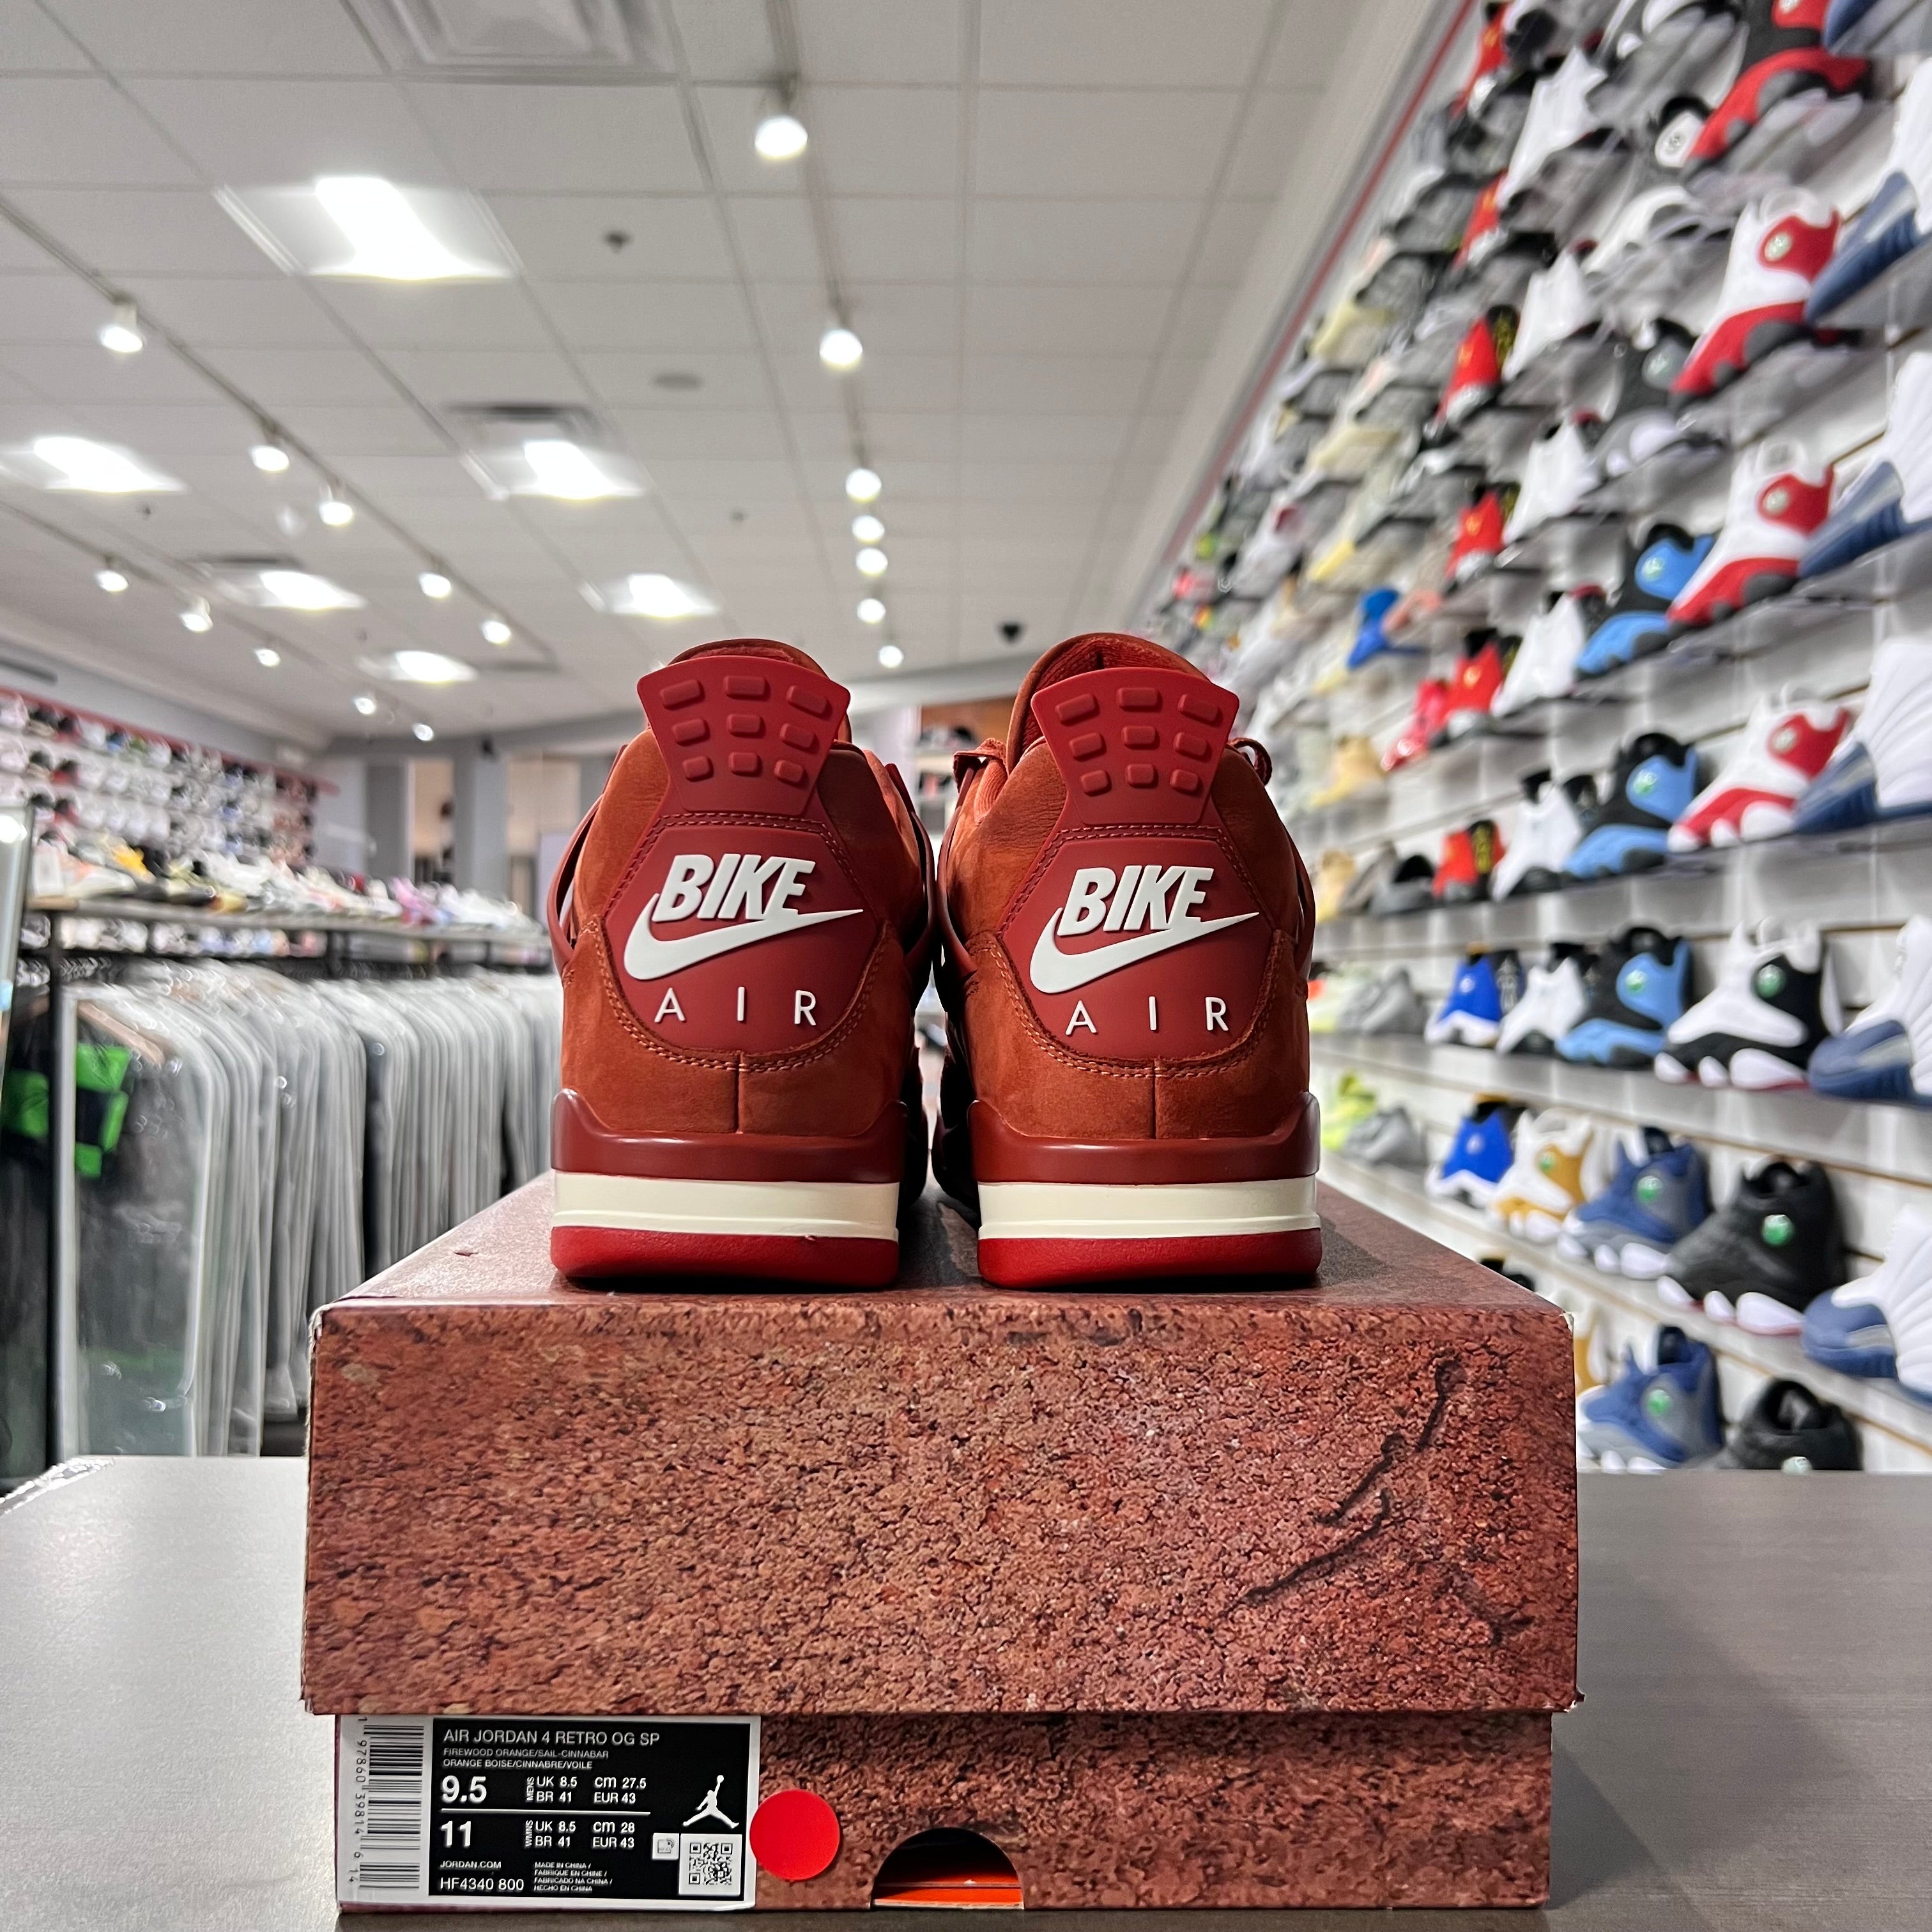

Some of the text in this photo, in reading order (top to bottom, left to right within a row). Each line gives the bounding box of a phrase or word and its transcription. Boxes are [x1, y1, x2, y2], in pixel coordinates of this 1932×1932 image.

[652, 853, 816, 923] BIKE
[1057, 864, 1215, 936] BIKE
[443, 1729, 660, 1747] AIR JORDAN 4 RETRO OG SP
[443, 1748, 609, 1759] FIREWOOD ORANGE/SAIL-CINNABAR
[356, 1740, 367, 1783] 97860
[443, 1758, 593, 1770] ORANGE BOISE/CINNABRE/VOILE
[441, 1775, 487, 1804] 9.5
[536, 1776, 554, 1788] UK
[560, 1777, 578, 1789] 8.5
[622, 1777, 647, 1790] 27.5
[536, 1791, 636, 1804] BR 41 EUR 43
[355, 1793, 366, 1835] 39814
[441, 1820, 471, 1848] 11
[535, 1821, 553, 1832] UK
[558, 1821, 576, 1834] 8.5
[620, 1822, 635, 1834] 28
[535, 1836, 634, 1849] BR 41 EUR 43
[440, 1860, 502, 1869] JORDAN.COM
[440, 1878, 525, 1892] HF4340 800
